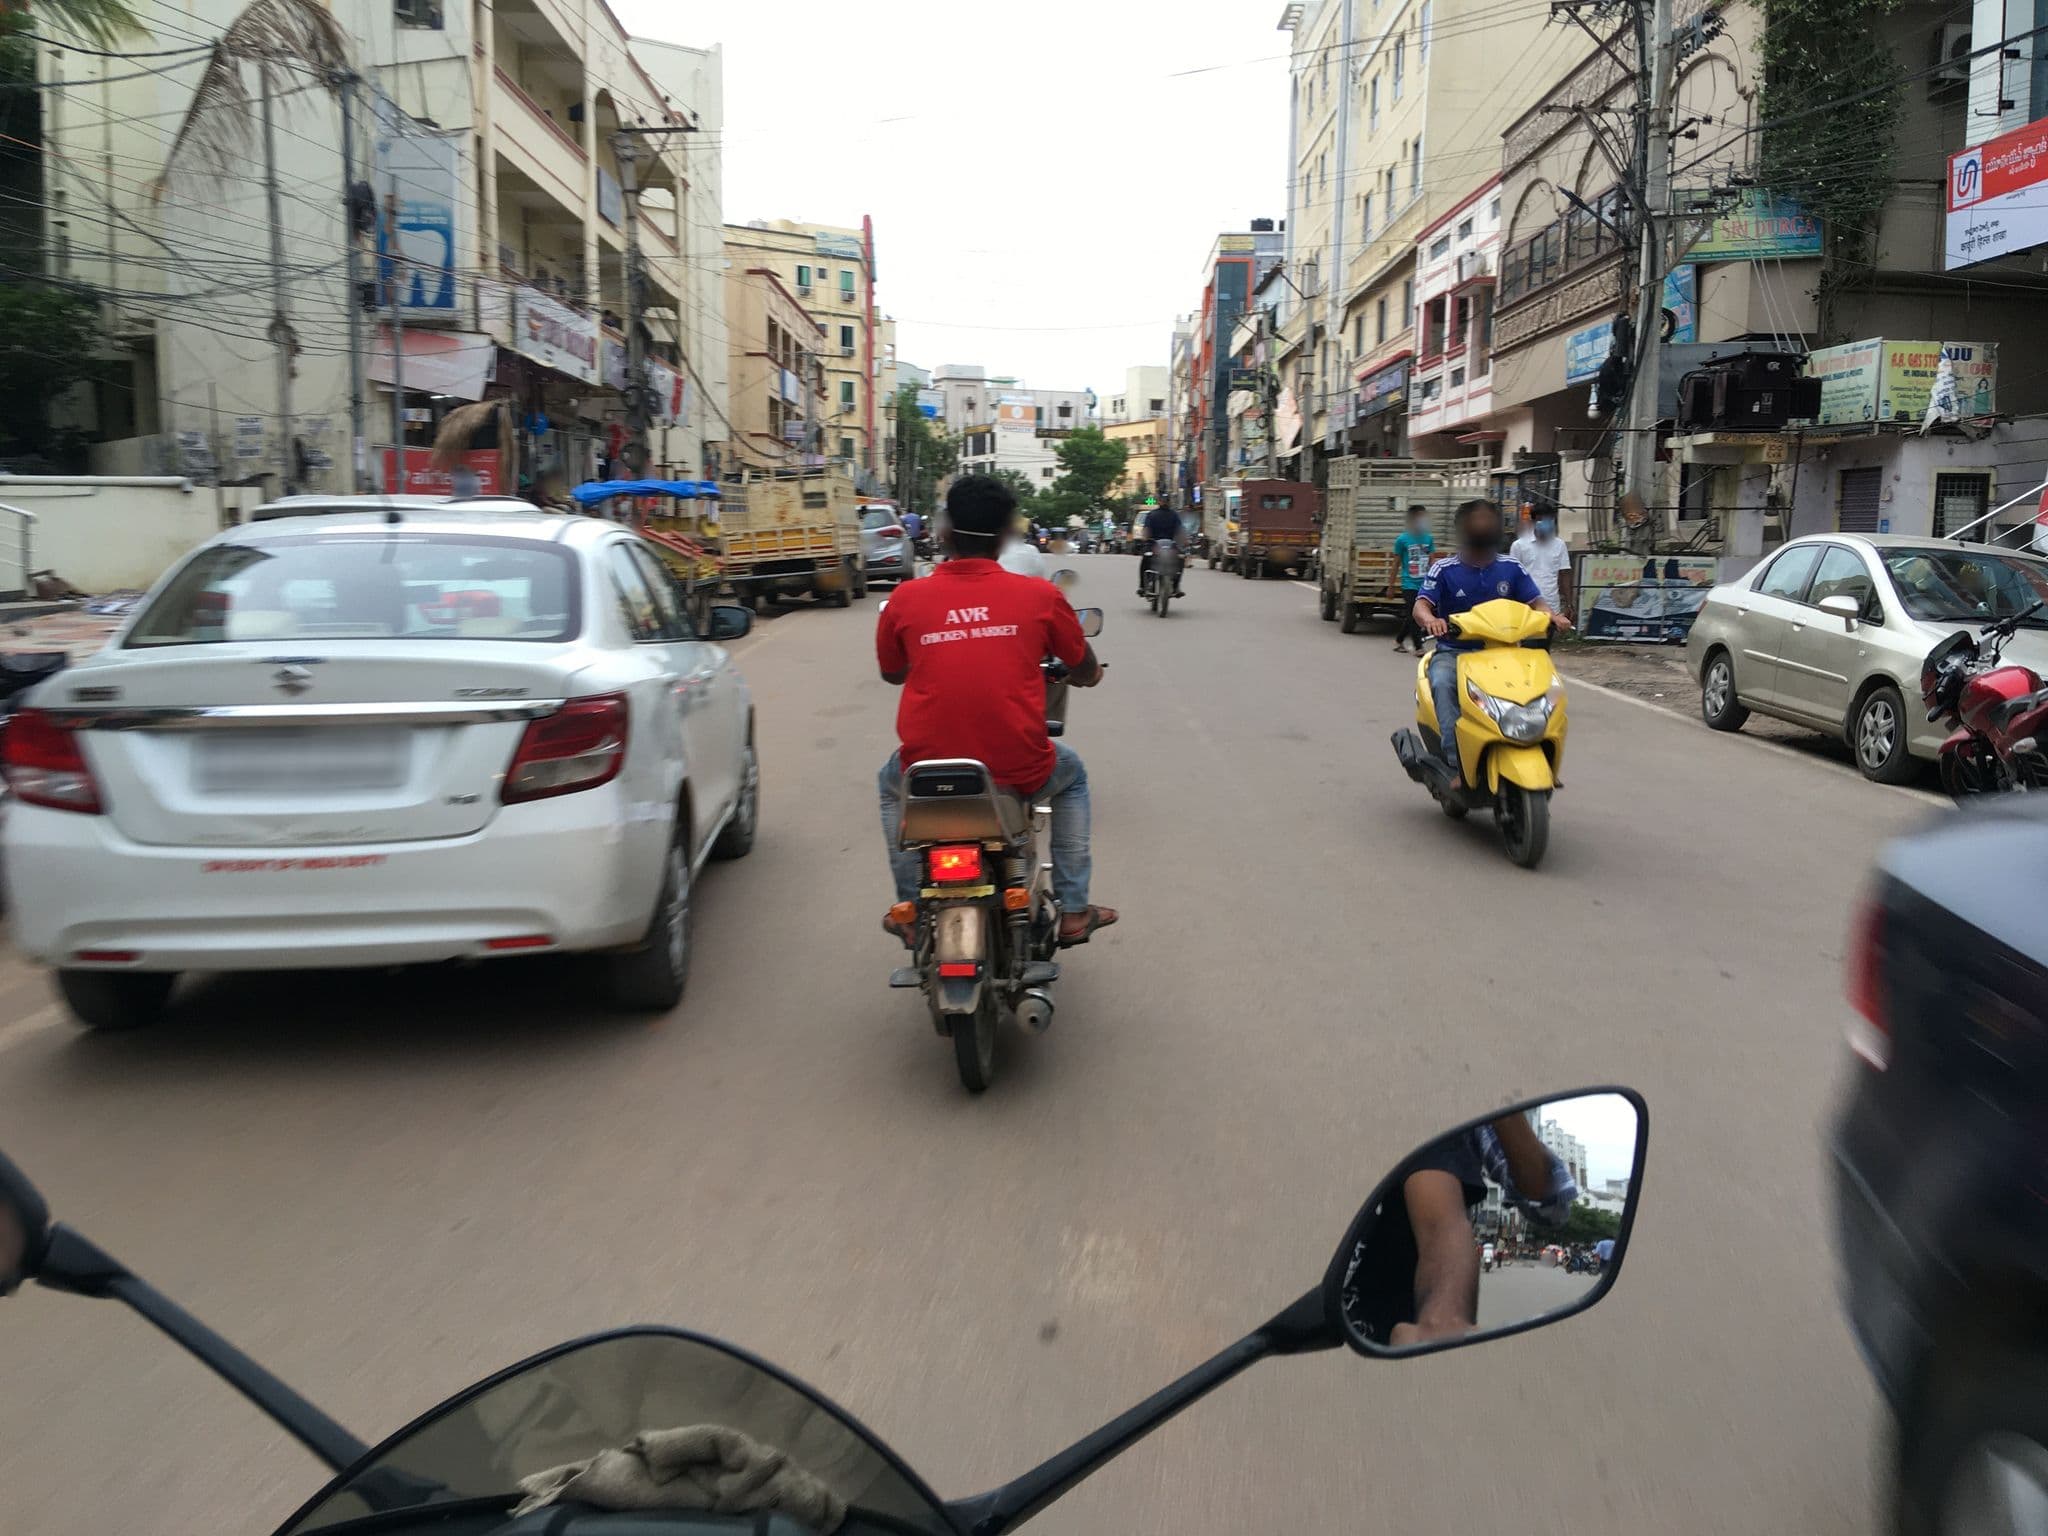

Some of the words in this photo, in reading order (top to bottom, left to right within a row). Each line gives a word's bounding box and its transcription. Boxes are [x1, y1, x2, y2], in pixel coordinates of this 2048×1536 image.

[1720, 219, 1749, 240] SRI
[944, 606, 990, 625] AVR
[920, 629, 968, 646] CHICKEN
[970, 625, 1019, 639] MARKET
